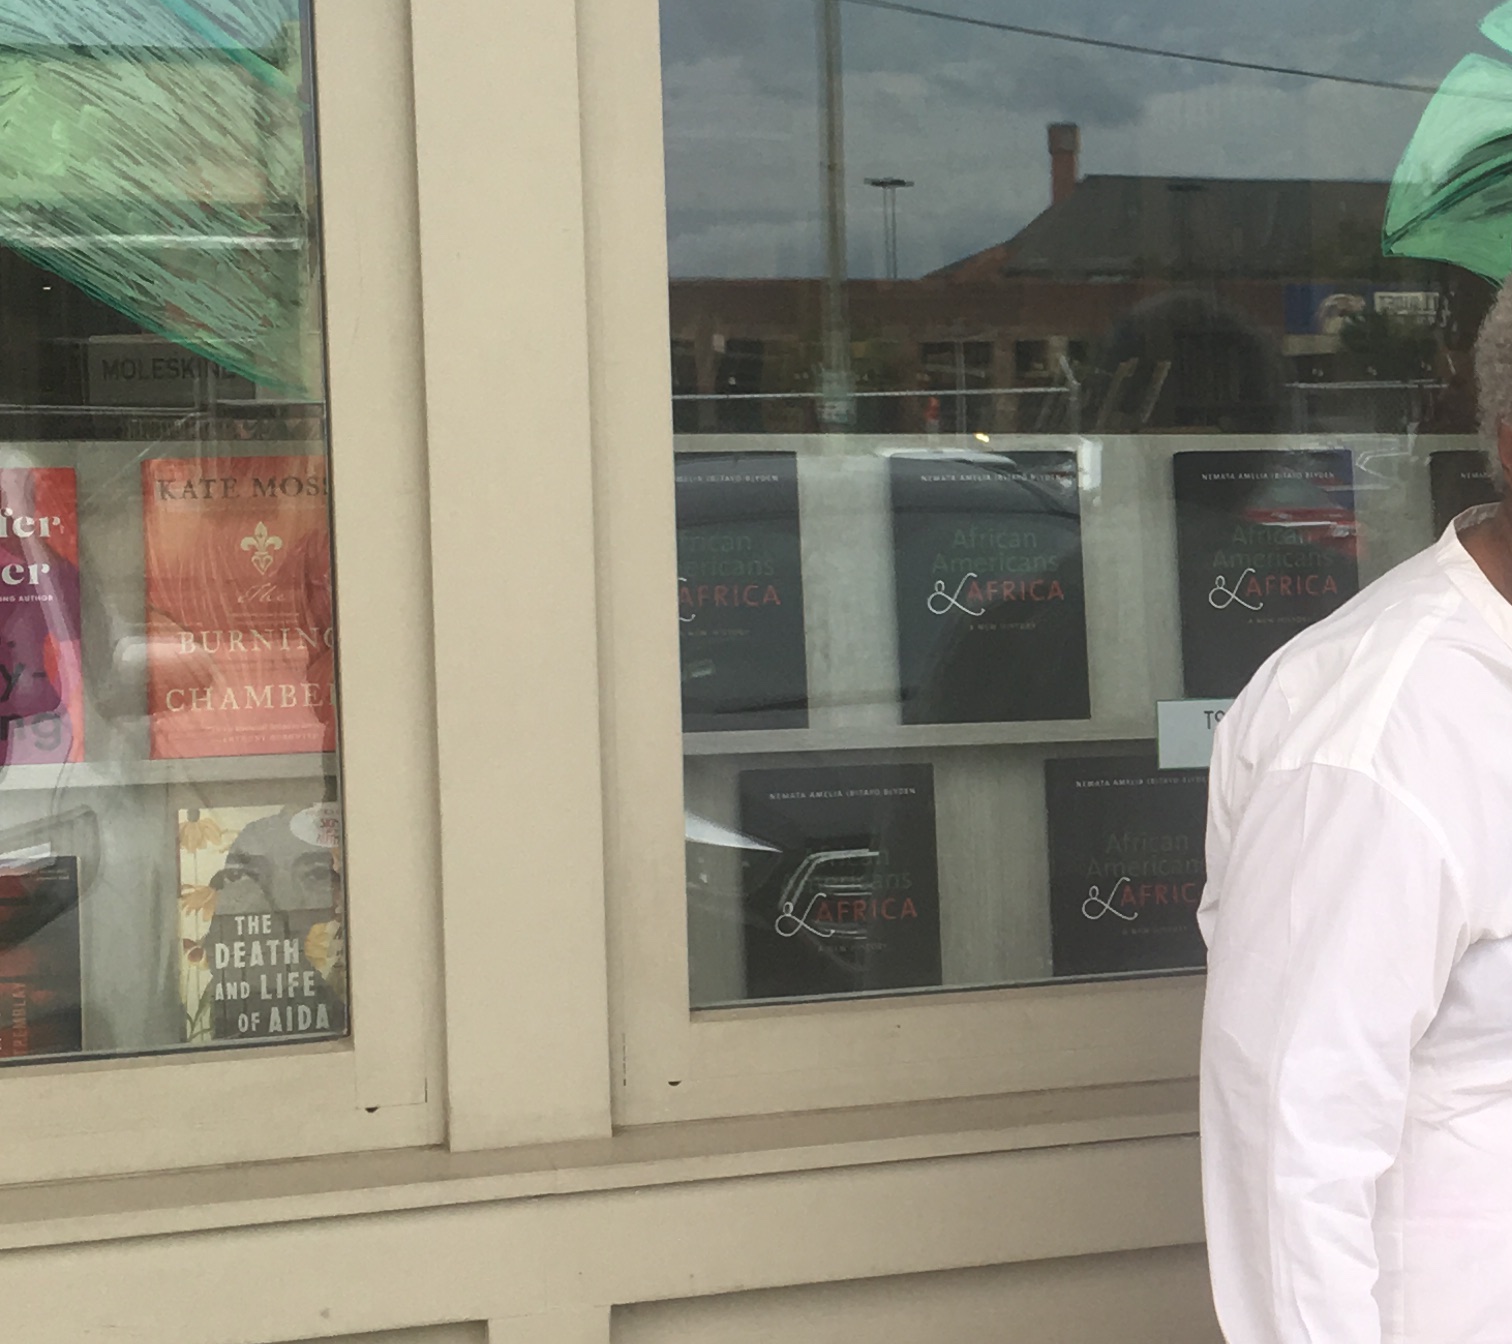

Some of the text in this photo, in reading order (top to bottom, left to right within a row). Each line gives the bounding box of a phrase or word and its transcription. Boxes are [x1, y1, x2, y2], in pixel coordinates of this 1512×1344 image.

[157, 477, 240, 501] KATE
[953, 528, 1038, 550] African
[931, 553, 1059, 574] Americans
[967, 579, 1065, 603] AFRICA
[1245, 574, 1338, 597] AFRICA
[165, 682, 336, 713] CHAMBE
[1105, 833, 1189, 855] African
[816, 897, 918, 923] AFRICA
[234, 913, 272, 935] THE
[214, 939, 300, 970] DEATH
[214, 970, 316, 1001] AND LIFE
[237, 1004, 330, 1034] OF AIDA
